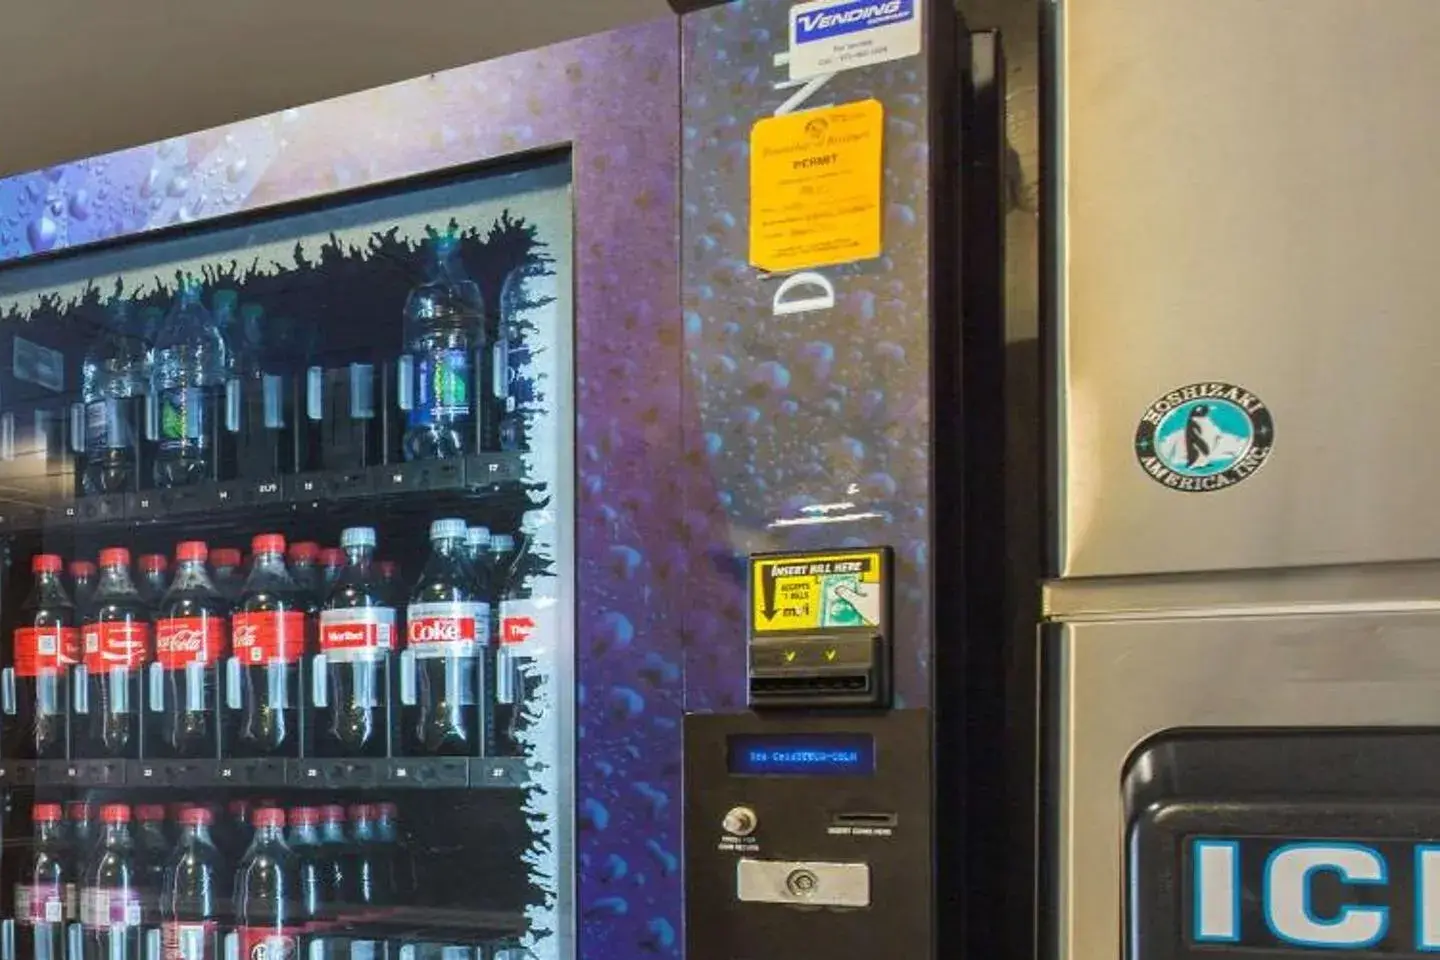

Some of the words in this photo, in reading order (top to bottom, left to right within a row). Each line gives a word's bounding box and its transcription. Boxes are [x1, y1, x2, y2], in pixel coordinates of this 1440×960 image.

[799, 1, 900, 32] VENDING
[1143, 383, 1263, 425] HOSHIZAKI
[771, 563, 807, 577] INSERT
[835, 561, 863, 573] HERE
[410, 619, 459, 643] Coke
